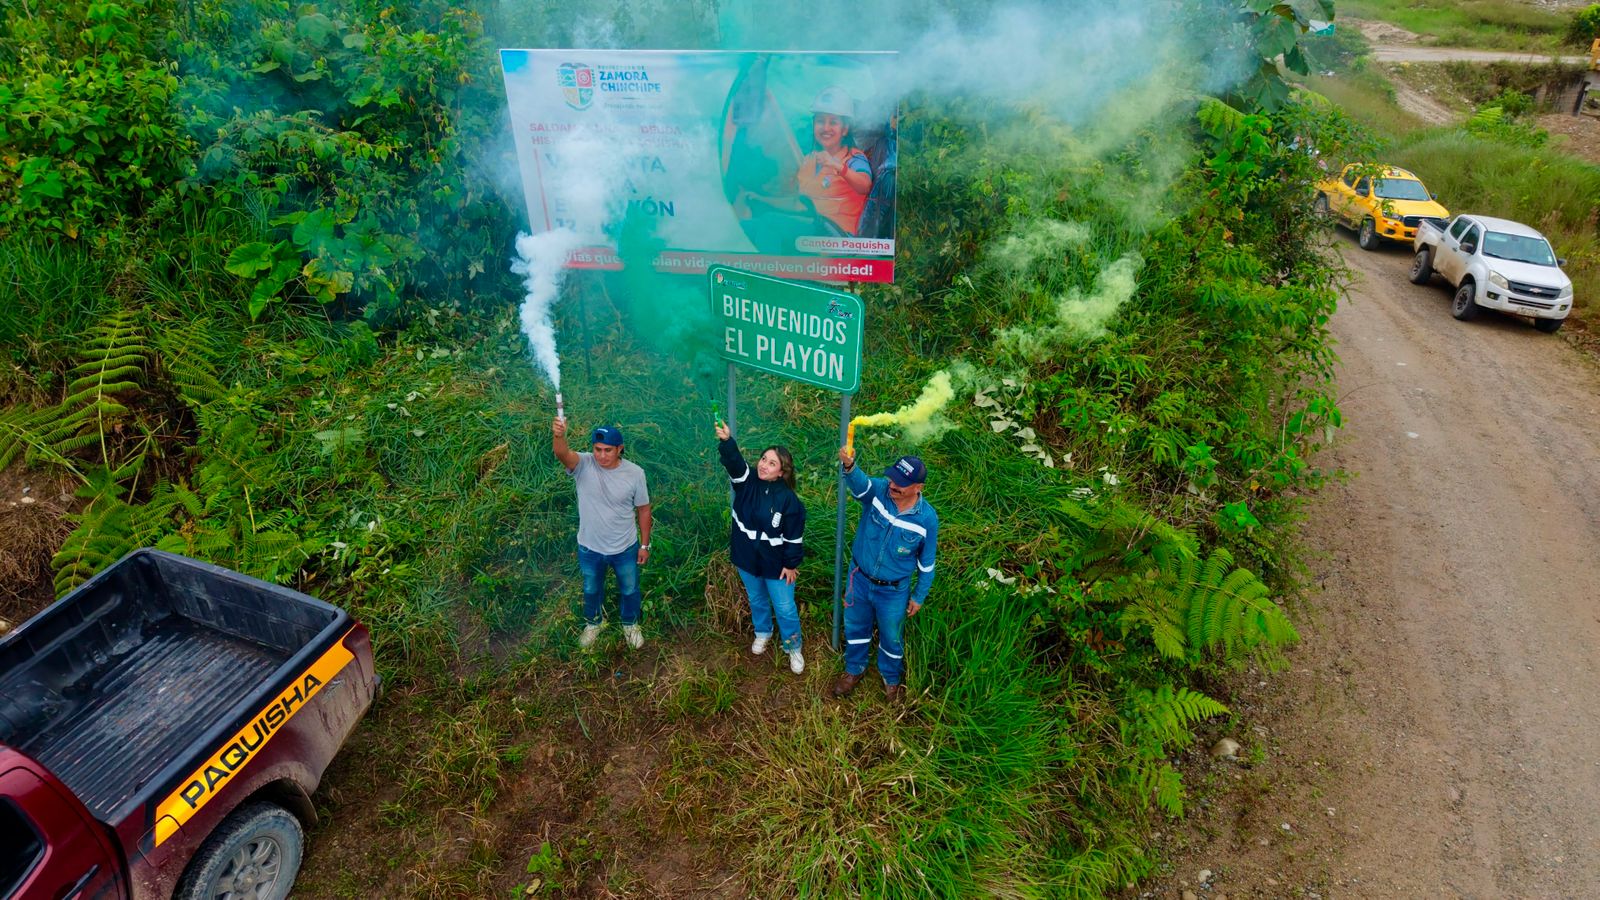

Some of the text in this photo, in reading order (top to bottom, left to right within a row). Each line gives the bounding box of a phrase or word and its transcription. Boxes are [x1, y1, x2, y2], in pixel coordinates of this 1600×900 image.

[599, 71, 649, 81] ZAMORA
[600, 82, 662, 92] CHINCHIPE
[801, 238, 891, 250] Cantón Paquisha
[594, 255, 620, 266] que
[735, 258, 802, 272] devuelven
[806, 262, 873, 276] dignidad!
[723, 294, 847, 345] BIENVENIDOS
[725, 327, 844, 382] EL PLAYÓN
[179, 673, 322, 809] PAQUISHA
